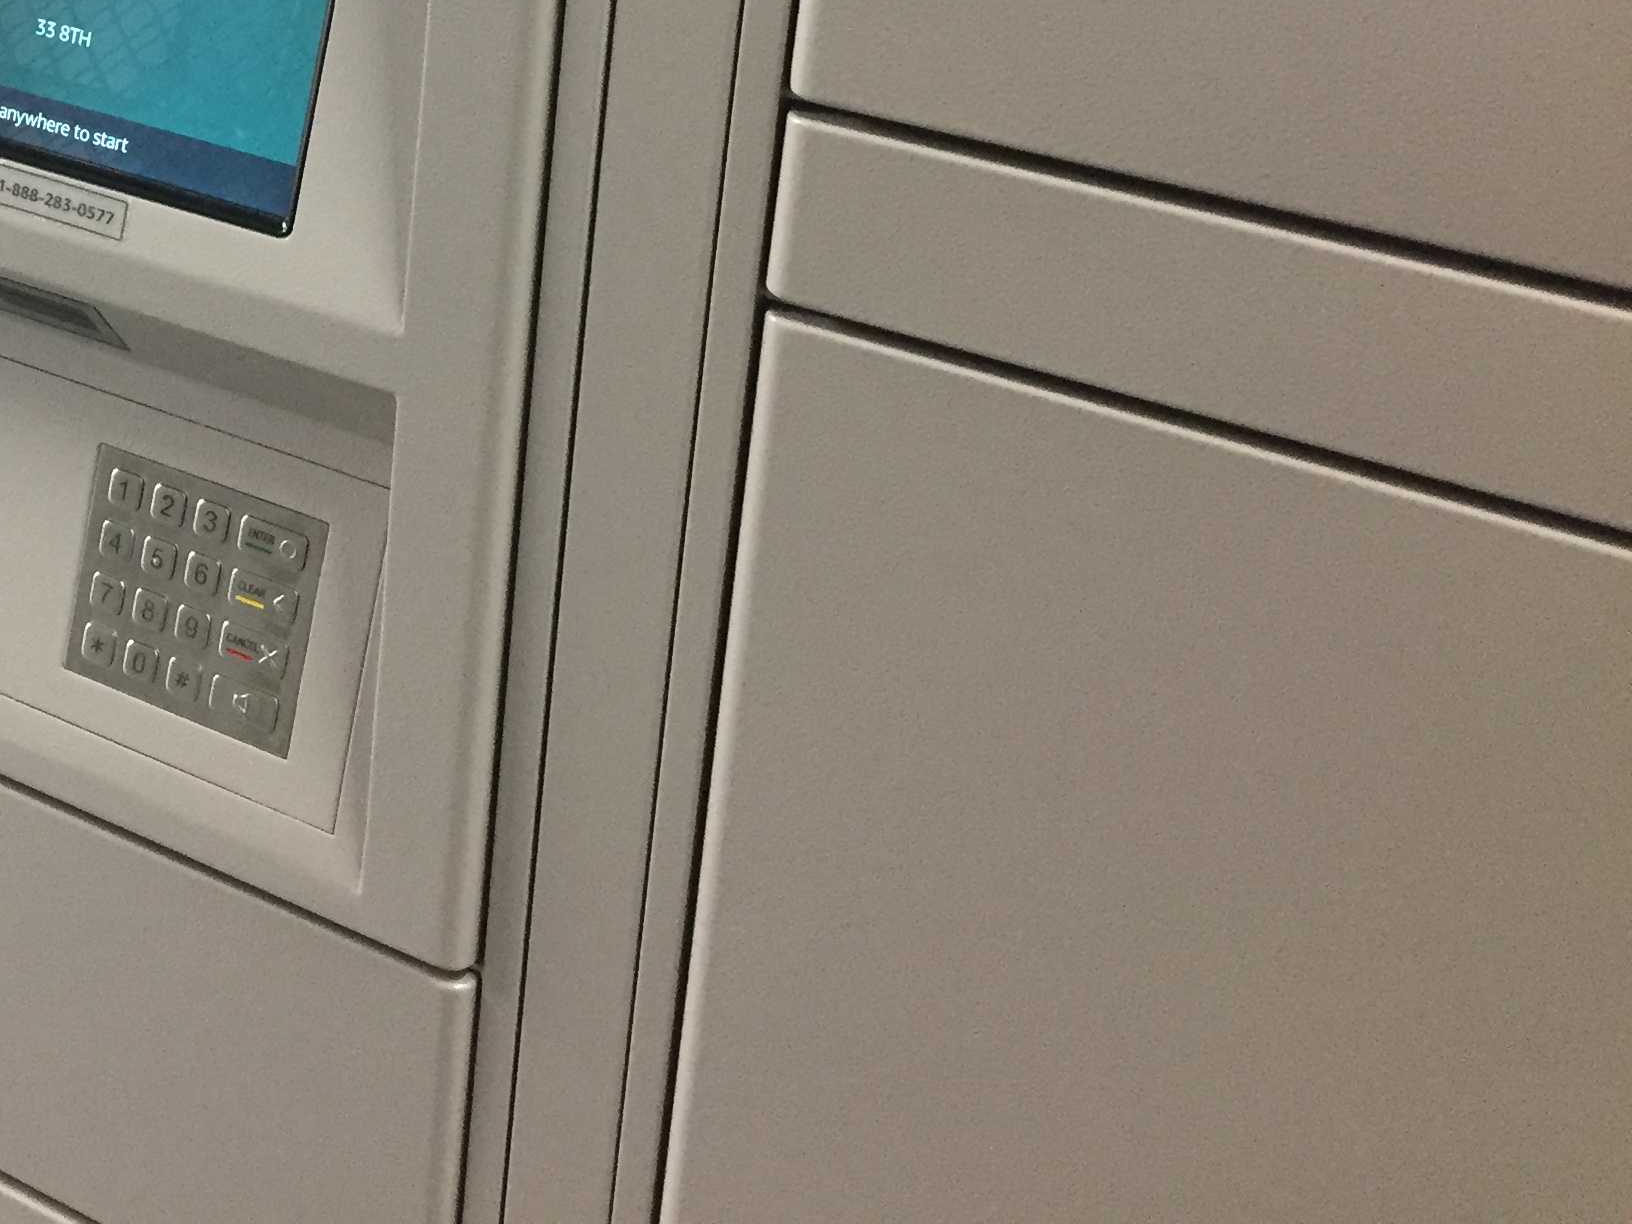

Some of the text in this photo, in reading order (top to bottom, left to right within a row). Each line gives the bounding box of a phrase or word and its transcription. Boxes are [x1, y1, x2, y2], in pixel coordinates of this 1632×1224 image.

[35, 18, 92, 48] 33 8TH
[73, 124, 90, 143] to
[92, 131, 129, 154] start
[118, 480, 129, 501] 1
[159, 494, 175, 518] 2
[204, 510, 218, 534] 3
[108, 533, 123, 554] 4
[150, 547, 164, 570] 5
[194, 563, 209, 586] 6
[100, 582, 114, 605] 7
[141, 600, 156, 622] 8
[184, 615, 199, 640] 9
[132, 650, 147, 674] 0
